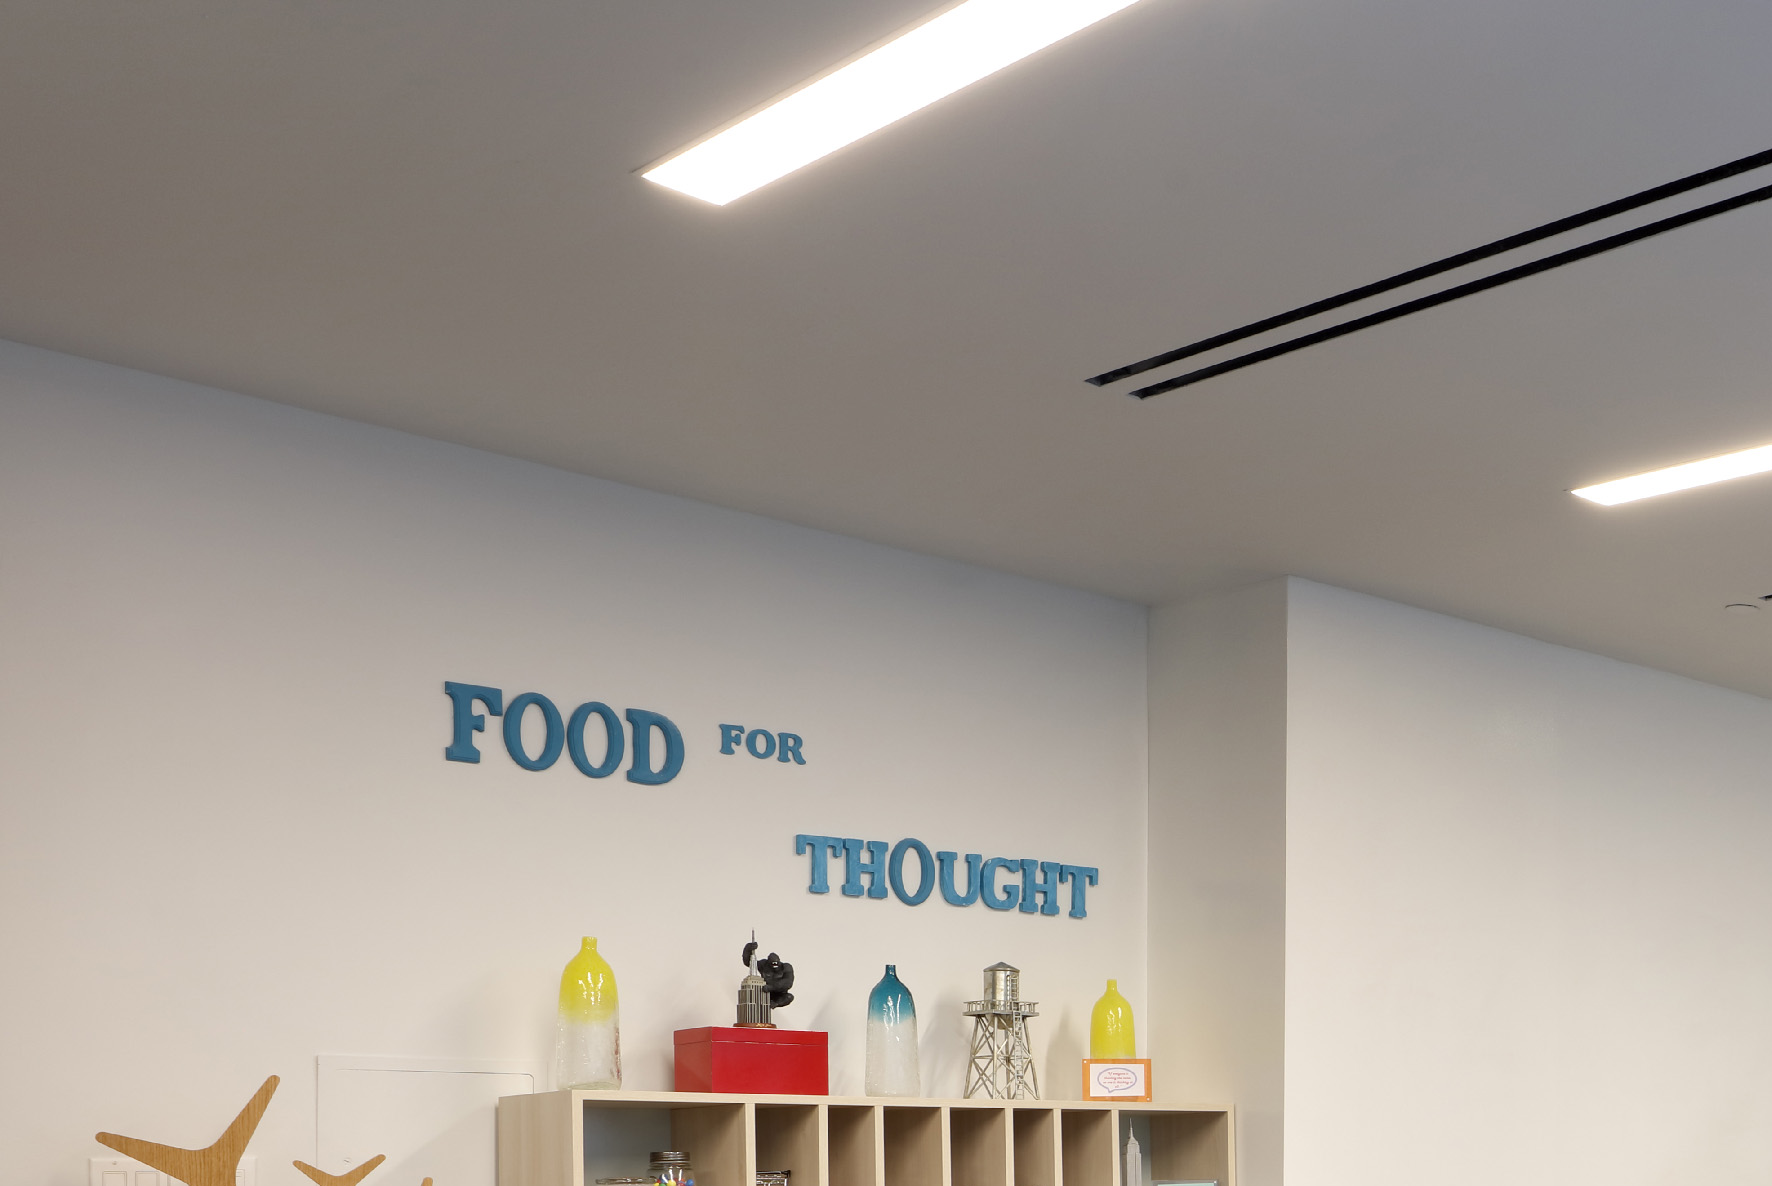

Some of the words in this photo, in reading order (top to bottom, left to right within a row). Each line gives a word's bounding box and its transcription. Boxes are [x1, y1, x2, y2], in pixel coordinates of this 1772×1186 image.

[445, 681, 685, 786] FOOD
[718, 723, 806, 765] FOR
[796, 834, 1098, 918] THOUGHT
